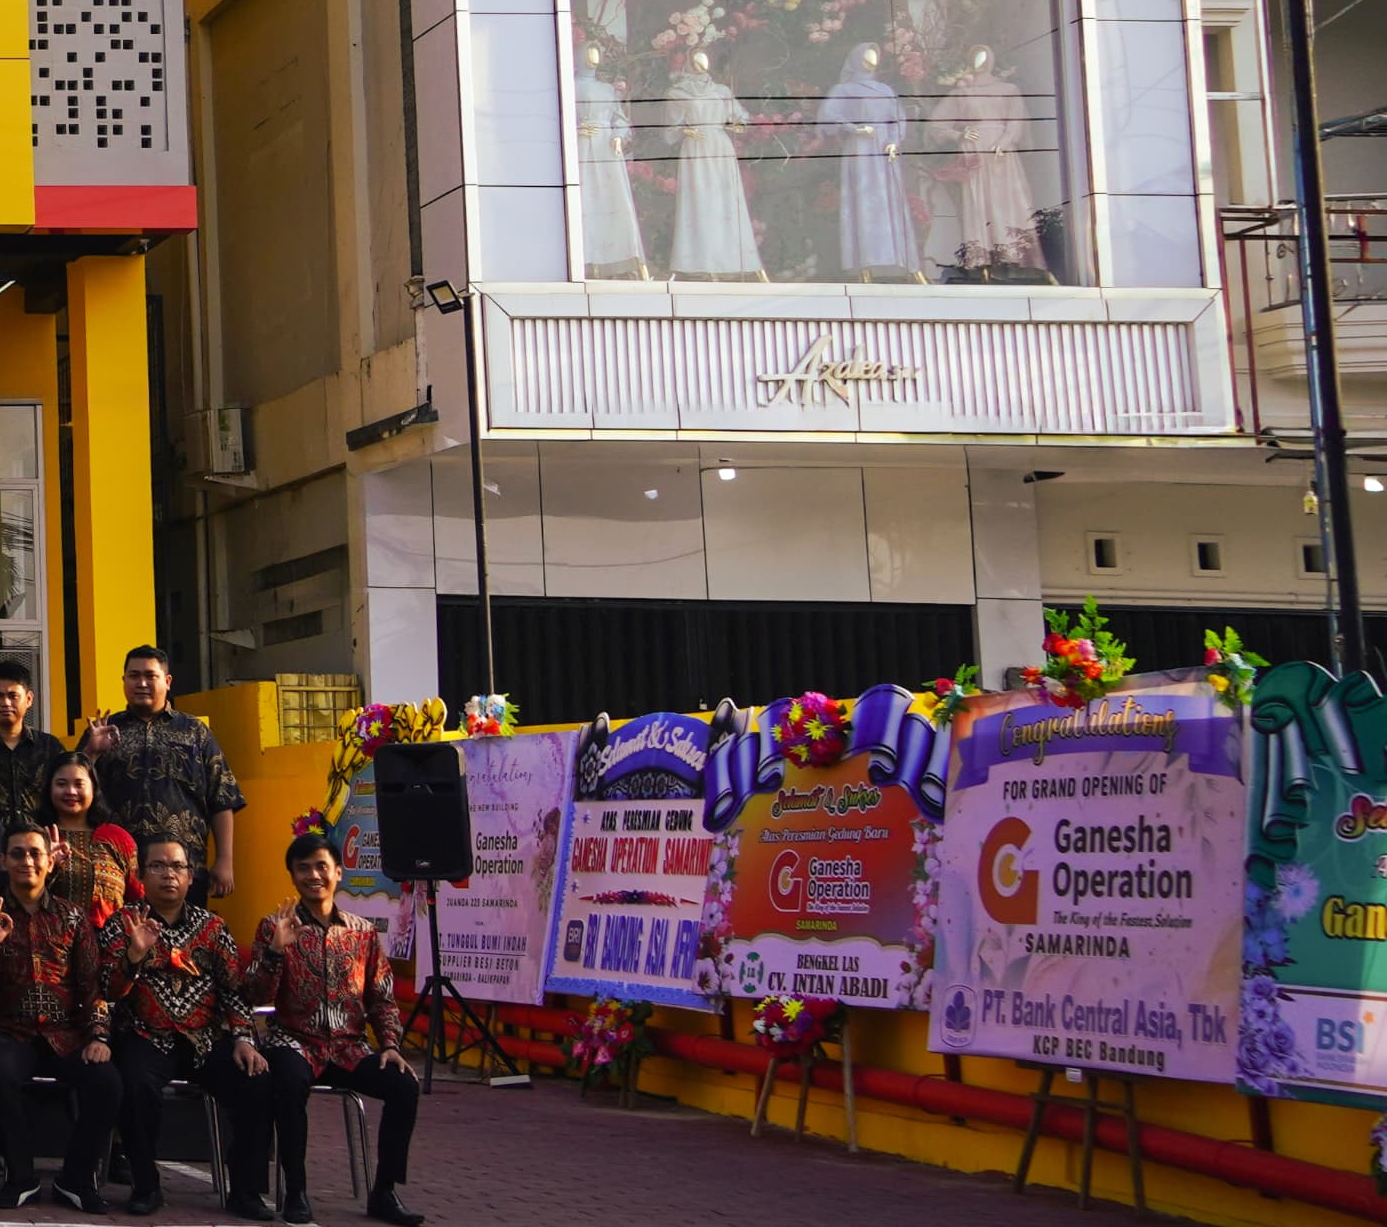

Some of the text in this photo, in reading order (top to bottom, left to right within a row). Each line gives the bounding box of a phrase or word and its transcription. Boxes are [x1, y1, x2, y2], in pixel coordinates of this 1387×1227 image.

[1000, 694, 1179, 765] Congratulations
[597, 724, 650, 777] Selamat
[647, 721, 670, 749] &
[772, 784, 826, 819] Selamat
[837, 780, 881, 815] Sukses
[1003, 772, 1168, 801] FOR GRAND OPENING OF
[491, 802, 520, 812] BUILDING
[621, 809, 662, 832] PERESMIAN
[665, 809, 694, 832] GEDUNG
[476, 831, 518, 853] Ganesha
[782, 827, 826, 843] Peresmian
[827, 825, 862, 844] Gedung
[862, 825, 889, 841] Baru
[1054, 815, 1172, 854] Ganesha
[475, 855, 524, 878] Operation
[571, 837, 660, 875] GANESHA OPERATION
[808, 854, 862, 879] Ganesha
[807, 878, 871, 901] Operation
[1053, 859, 1193, 906] Operation
[481, 898, 519, 909] SAMARINDA
[795, 919, 838, 932] SAMARINDA
[447, 933, 527, 952] TUNGGUL BUMI INDAH
[582, 913, 669, 977] BRI BANDUNG ASIA
[1025, 932, 1131, 959] SAMARINDA
[474, 956, 520, 972] BESI BETON
[796, 954, 860, 973] BENGKEL LAS
[767, 972, 788, 992] CV.
[791, 973, 836, 996] INTAN
[839, 977, 889, 1000] ABADI
[982, 988, 1227, 1048] PT. Bank Central Asia, Tbk
[1033, 1034, 1165, 1072] KCP BEC Bandung
